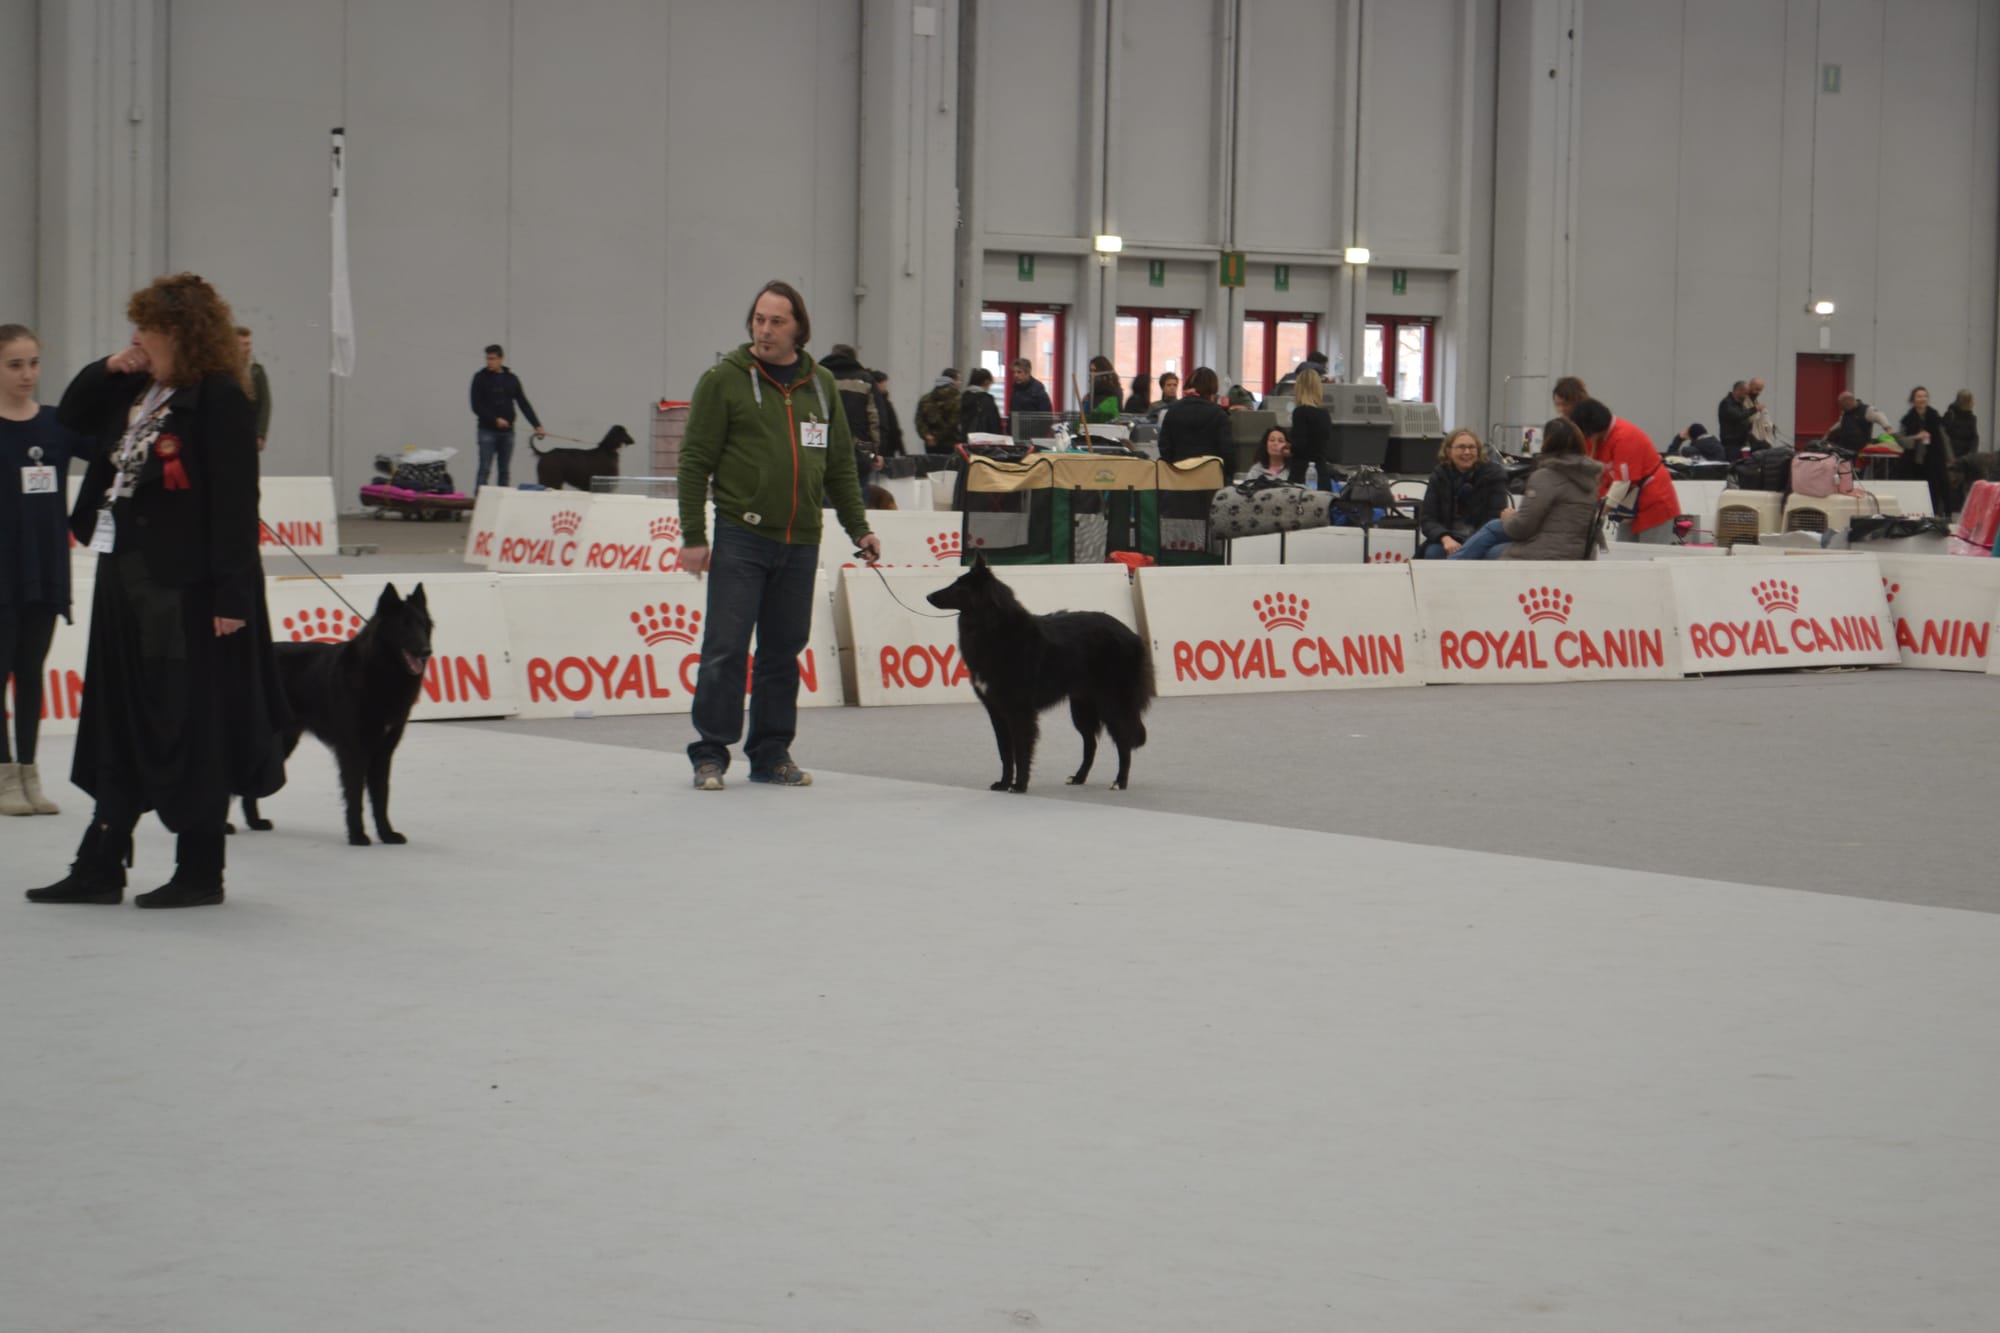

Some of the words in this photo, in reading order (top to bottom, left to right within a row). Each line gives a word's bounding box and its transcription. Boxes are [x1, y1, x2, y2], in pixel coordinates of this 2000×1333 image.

[808, 432, 825, 446] 21
[258, 520, 323, 546] ANIN
[499, 536, 555, 567] ROYAL
[585, 543, 653, 573] ROYAL
[1173, 638, 1287, 682] ROYAL
[1292, 633, 1405, 677] CANIN
[1440, 629, 1548, 670] ROYAL
[1554, 628, 1665, 669] CANIN
[1689, 619, 1789, 659] ROYAL
[1790, 616, 1885, 653] CANIN
[1895, 617, 1990, 658] ANIN
[527, 653, 671, 704] ROYAL
